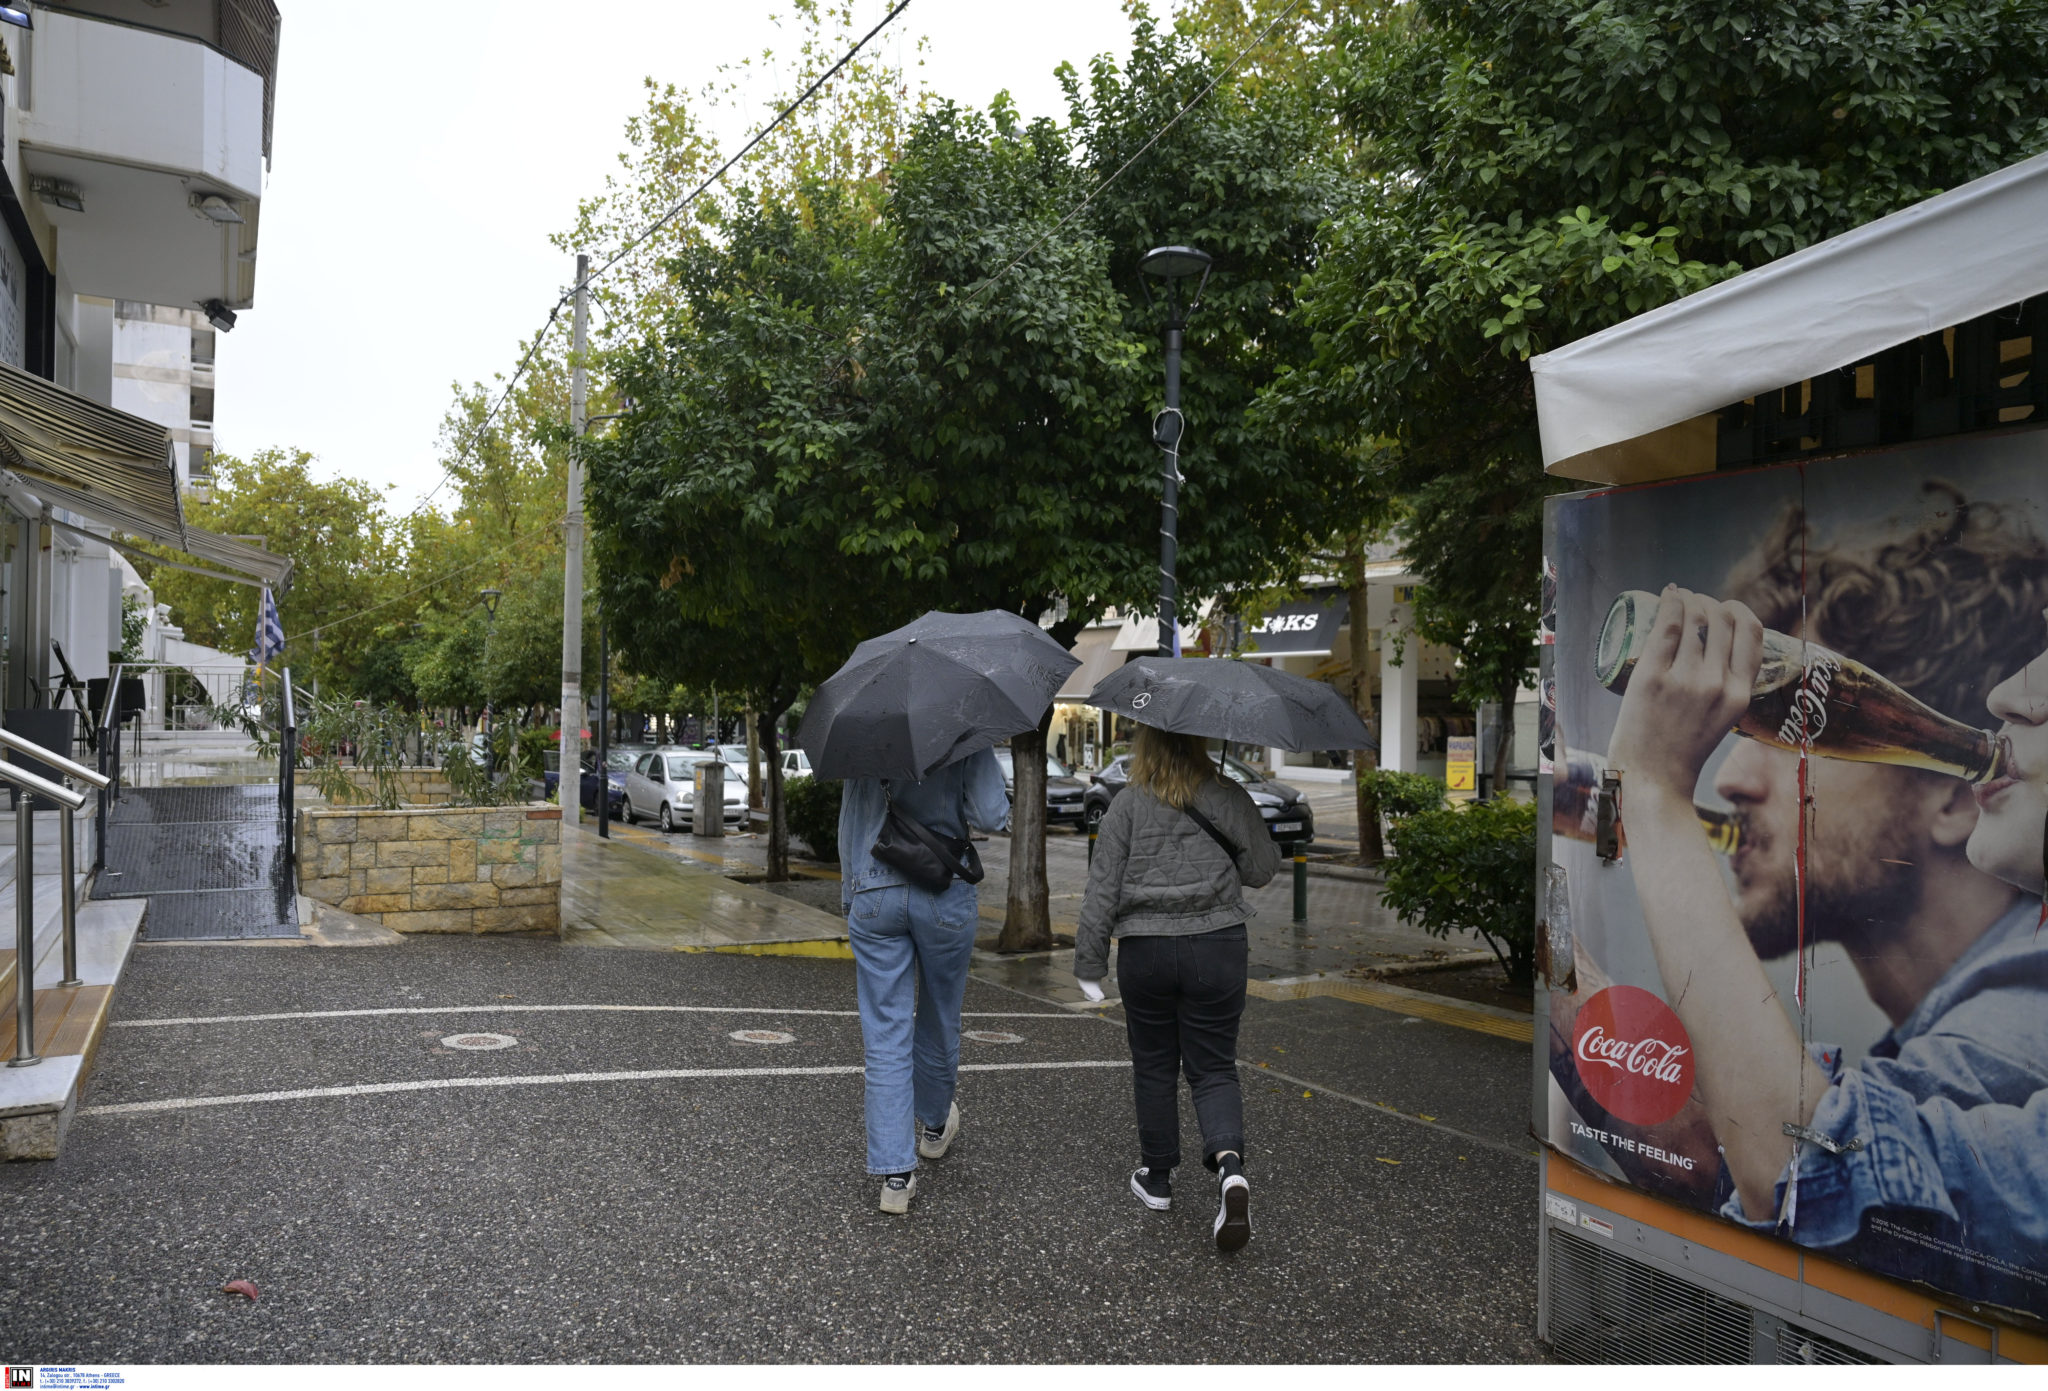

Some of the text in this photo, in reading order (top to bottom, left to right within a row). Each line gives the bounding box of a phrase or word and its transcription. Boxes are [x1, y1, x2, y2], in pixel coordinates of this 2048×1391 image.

[1578, 1026, 1689, 1084] Coca-Cola
[1570, 1122, 1608, 1143] TASTE
[1611, 1134, 1635, 1152] THE
[1871, 1224, 1882, 1232] and
[1882, 1227, 1892, 1236] the
[1893, 1231, 1920, 1245] Dynamic
[1920, 1240, 1942, 1252] Ribbon
[1942, 1248, 1953, 1256] are
[1953, 1251, 1986, 1267] registered
[1986, 1261, 2024, 1280] trademarks
[1890, 1222, 1901, 1231] The
[1902, 1226, 1932, 1242] Coca-Cola
[2008, 1262, 2020, 1271] the
